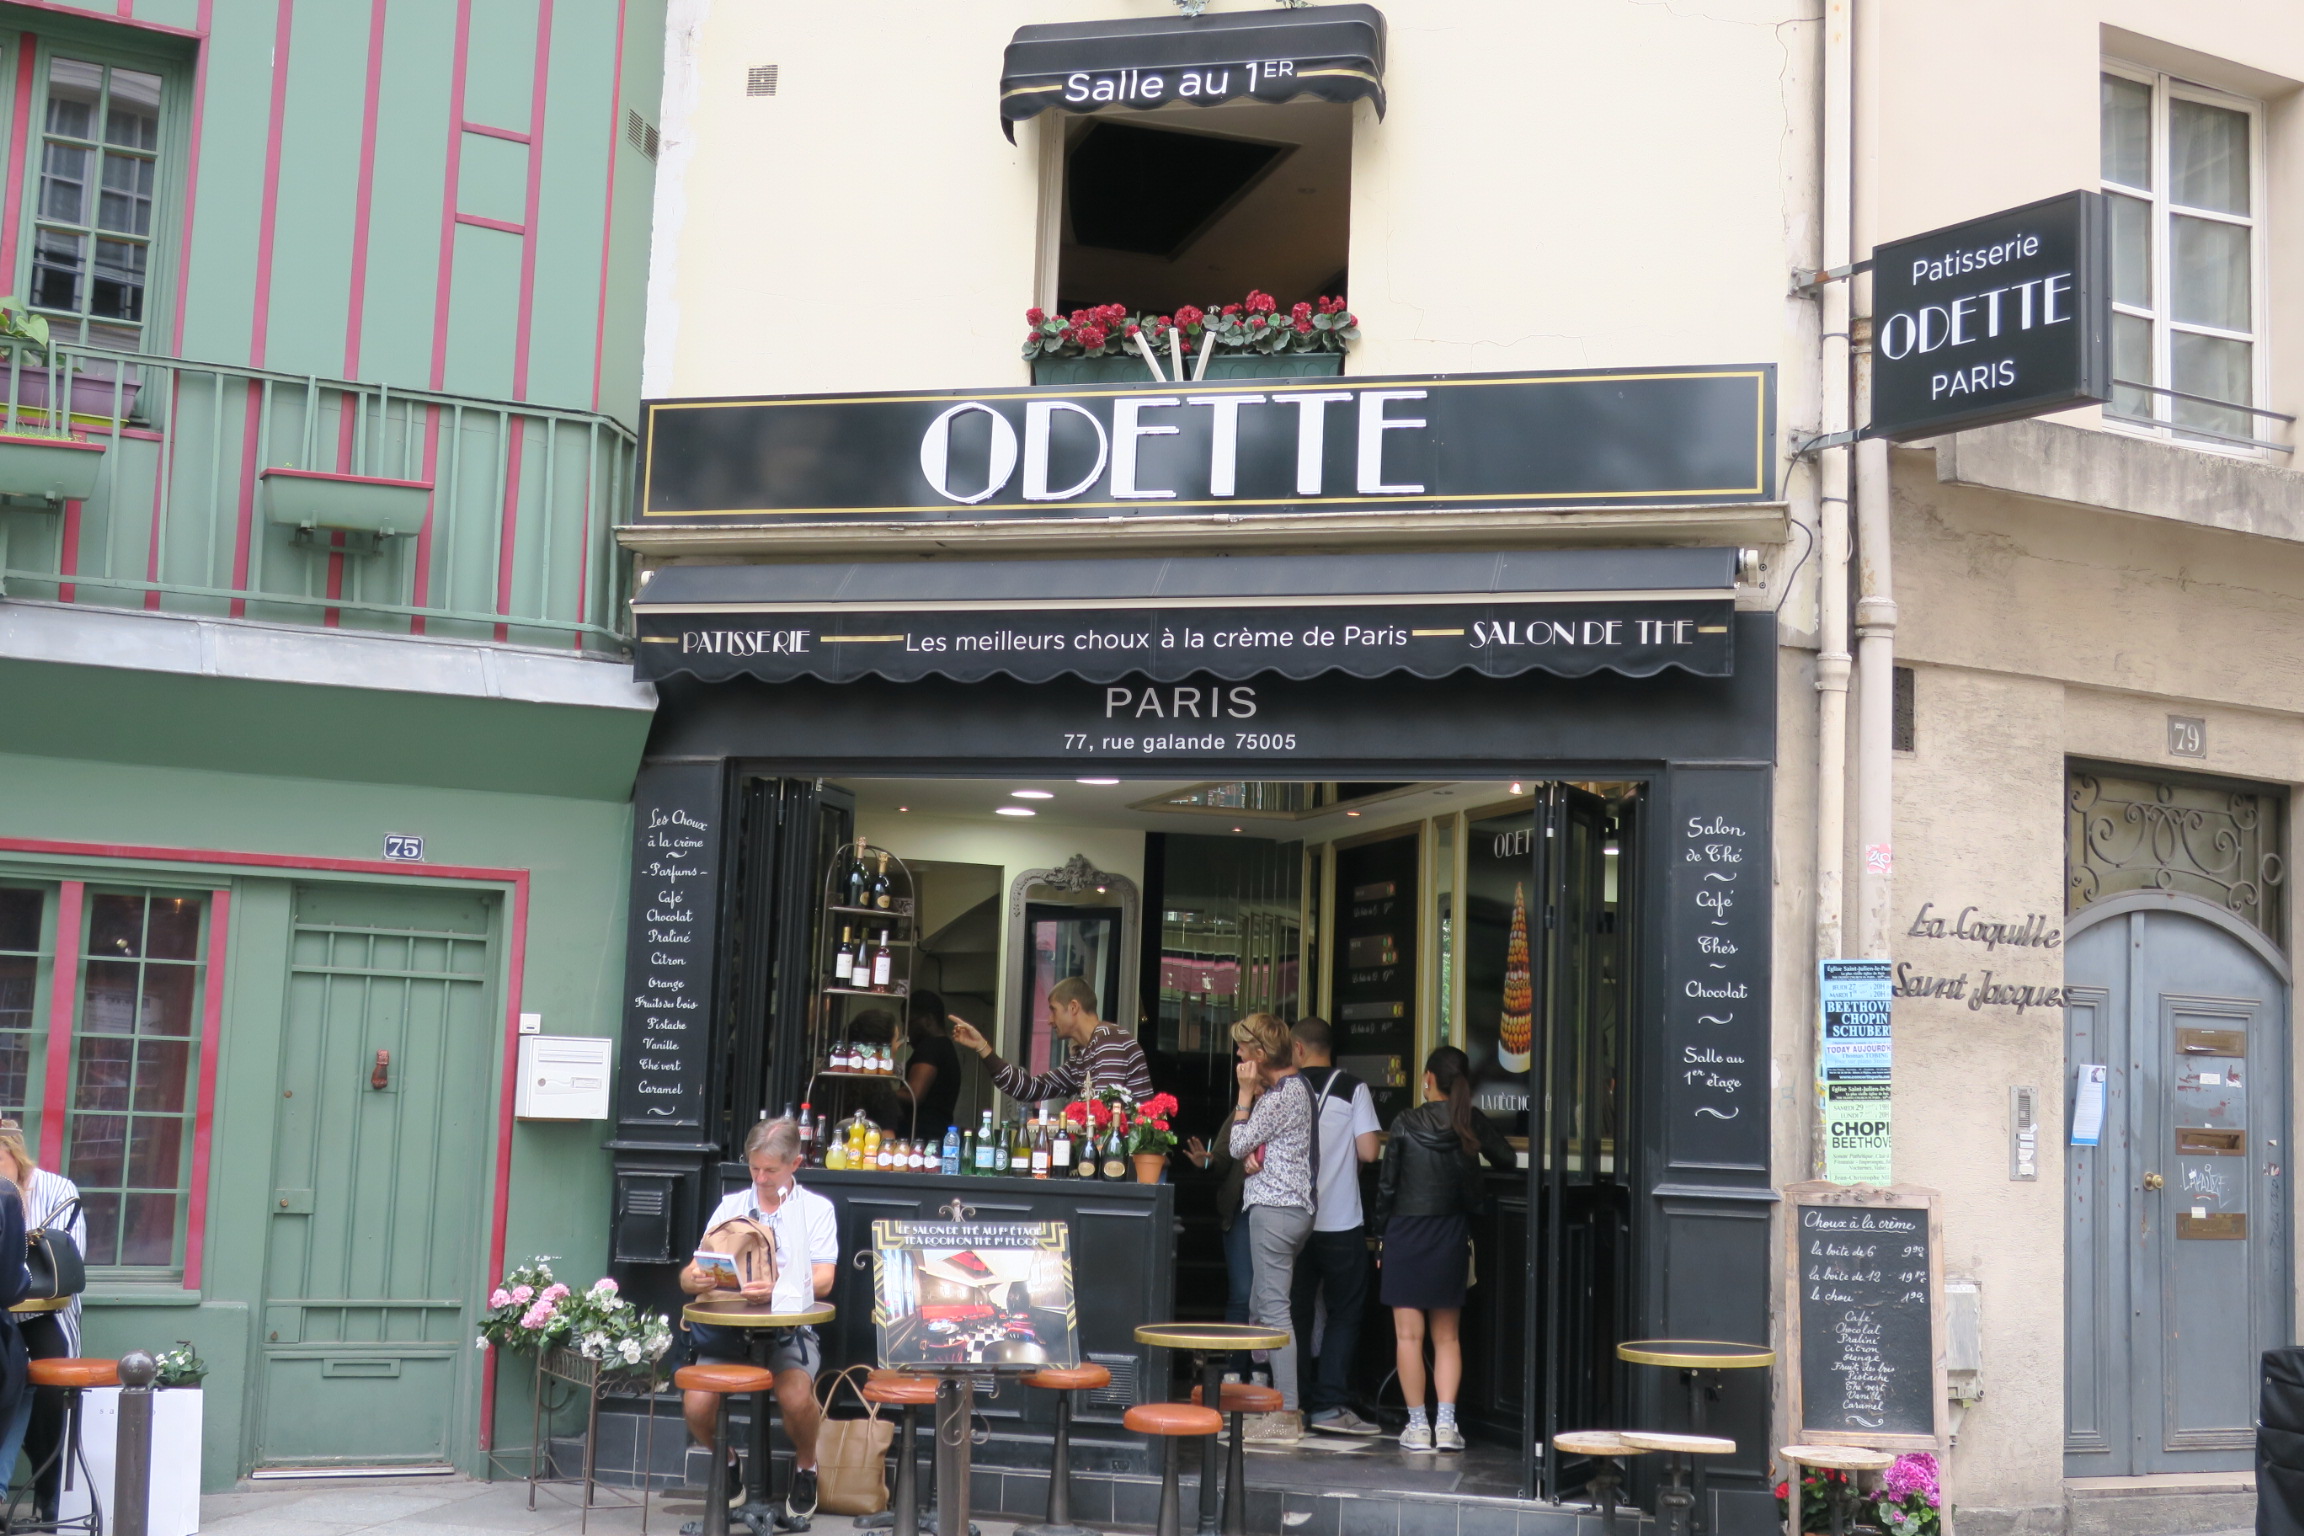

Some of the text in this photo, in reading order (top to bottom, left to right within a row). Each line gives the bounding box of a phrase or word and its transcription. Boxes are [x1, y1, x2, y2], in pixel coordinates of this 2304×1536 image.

[1064, 70, 1164, 102] Salle
[1178, 71, 1229, 97] au
[1912, 233, 2039, 286] Patisserie
[1881, 272, 2072, 360] ODETTE
[1932, 359, 2016, 401] PARIS
[920, 390, 1428, 504] ODETTE
[682, 629, 810, 657] PATISSERIE
[905, 624, 1409, 653] Les meilleurs choux à la crème de Paris
[1469, 619, 1694, 649] SALON DE THE
[1105, 686, 1259, 719] PARIS
[1064, 732, 1297, 754] 77, rue galande 75005
[2174, 722, 2200, 752] 79
[648, 808, 708, 831] Les Choux
[1687, 816, 1746, 838] Salon
[388, 837, 419, 857] 75
[659, 832, 671, 848] la
[674, 836, 703, 848] crème
[1494, 828, 1535, 859] ODET
[1686, 844, 1743, 863] de Thé
[650, 862, 697, 884] Parfums
[658, 890, 684, 909] Café
[1696, 889, 1734, 917] Café
[646, 909, 693, 922] Chocolat
[648, 928, 691, 943] Praliné
[1907, 902, 2062, 951] La Coquille
[1697, 935, 1739, 954] Thés
[650, 951, 687, 965] Citron
[648, 977, 685, 992] Orange
[1685, 980, 1748, 999] Chocolat
[1892, 962, 2074, 1016] Saint Jacques
[635, 995, 662, 1008] Fruits
[676, 996, 698, 1010] bois
[1827, 1001, 1891, 1013] BEETHOVE
[647, 1017, 687, 1030] Pistache
[1841, 1013, 1888, 1025] CHOPIN
[642, 1037, 679, 1051] Vanille
[639, 1058, 682, 1071] Thé vert
[1684, 1046, 1745, 1064] Salle au
[638, 1080, 683, 1095] Caramel
[1706, 1072, 1742, 1093] étage
[1831, 1121, 1890, 1136] CHOPI
[1832, 1136, 1891, 1149] BEETHOVE
[1804, 1211, 1847, 1228] Choux
[1861, 1213, 1875, 1229] la
[1878, 1216, 1916, 1231] crème
[1810, 1240, 1823, 1257] la
[1852, 1246, 1866, 1257] de
[1866, 1245, 1877, 1258] 6
[1809, 1265, 1821, 1282] la
[1851, 1270, 1866, 1283] de
[1866, 1271, 1882, 1283] 12
[1810, 1286, 1821, 1302] le
[1825, 1288, 1854, 1302] chou
[1844, 1310, 1875, 1326] Café
[1835, 1322, 1882, 1335] Chocolat
[1836, 1333, 1880, 1345] Praliné
[1845, 1371, 1889, 1382] Pistache
[1842, 1399, 1884, 1411] Caramel
[1846, 1391, 1881, 1401] Vanille
